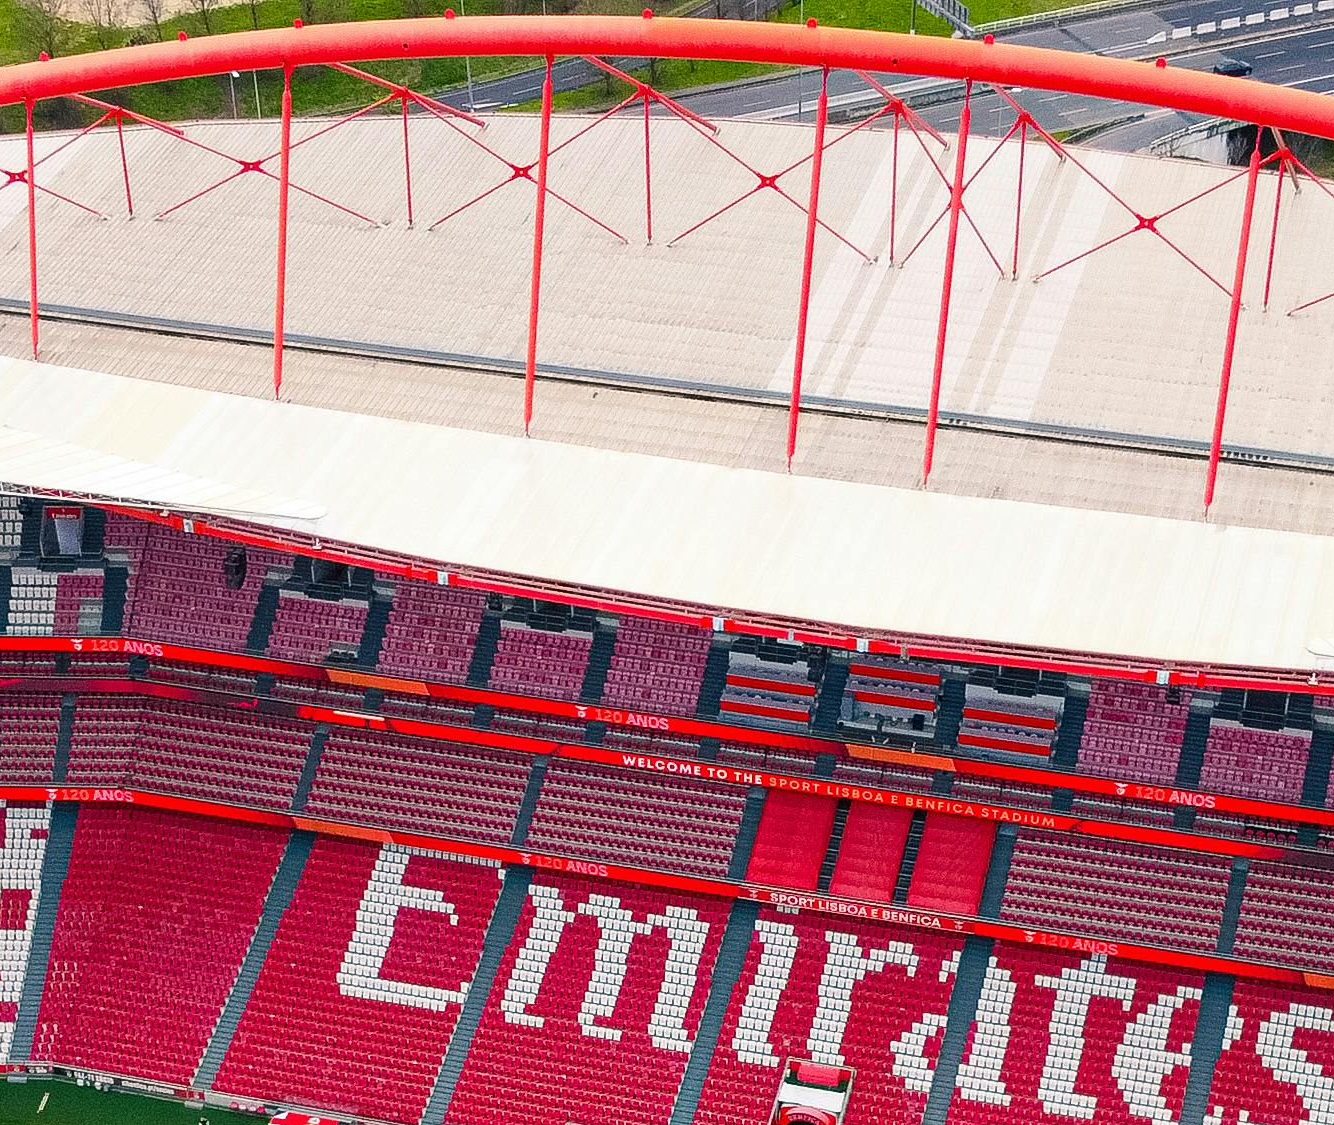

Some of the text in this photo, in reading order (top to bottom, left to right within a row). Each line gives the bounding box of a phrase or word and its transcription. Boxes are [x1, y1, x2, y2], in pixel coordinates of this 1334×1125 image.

[91, 640, 163, 656] 120 ANOS
[596, 708, 669, 730] 120 ANOS
[61, 789, 134, 802] 120 ANOS
[623, 755, 1056, 827] WELCOME TO THE SPORT LISBOA E BENFICA STADIUM
[1136, 786, 1216, 808] 120 ANOS
[536, 856, 609, 877] 120 ANOS
[770, 893, 942, 928] SPORT LISBOA E BENFICA
[1040, 933, 1118, 955] 120 ANOS
